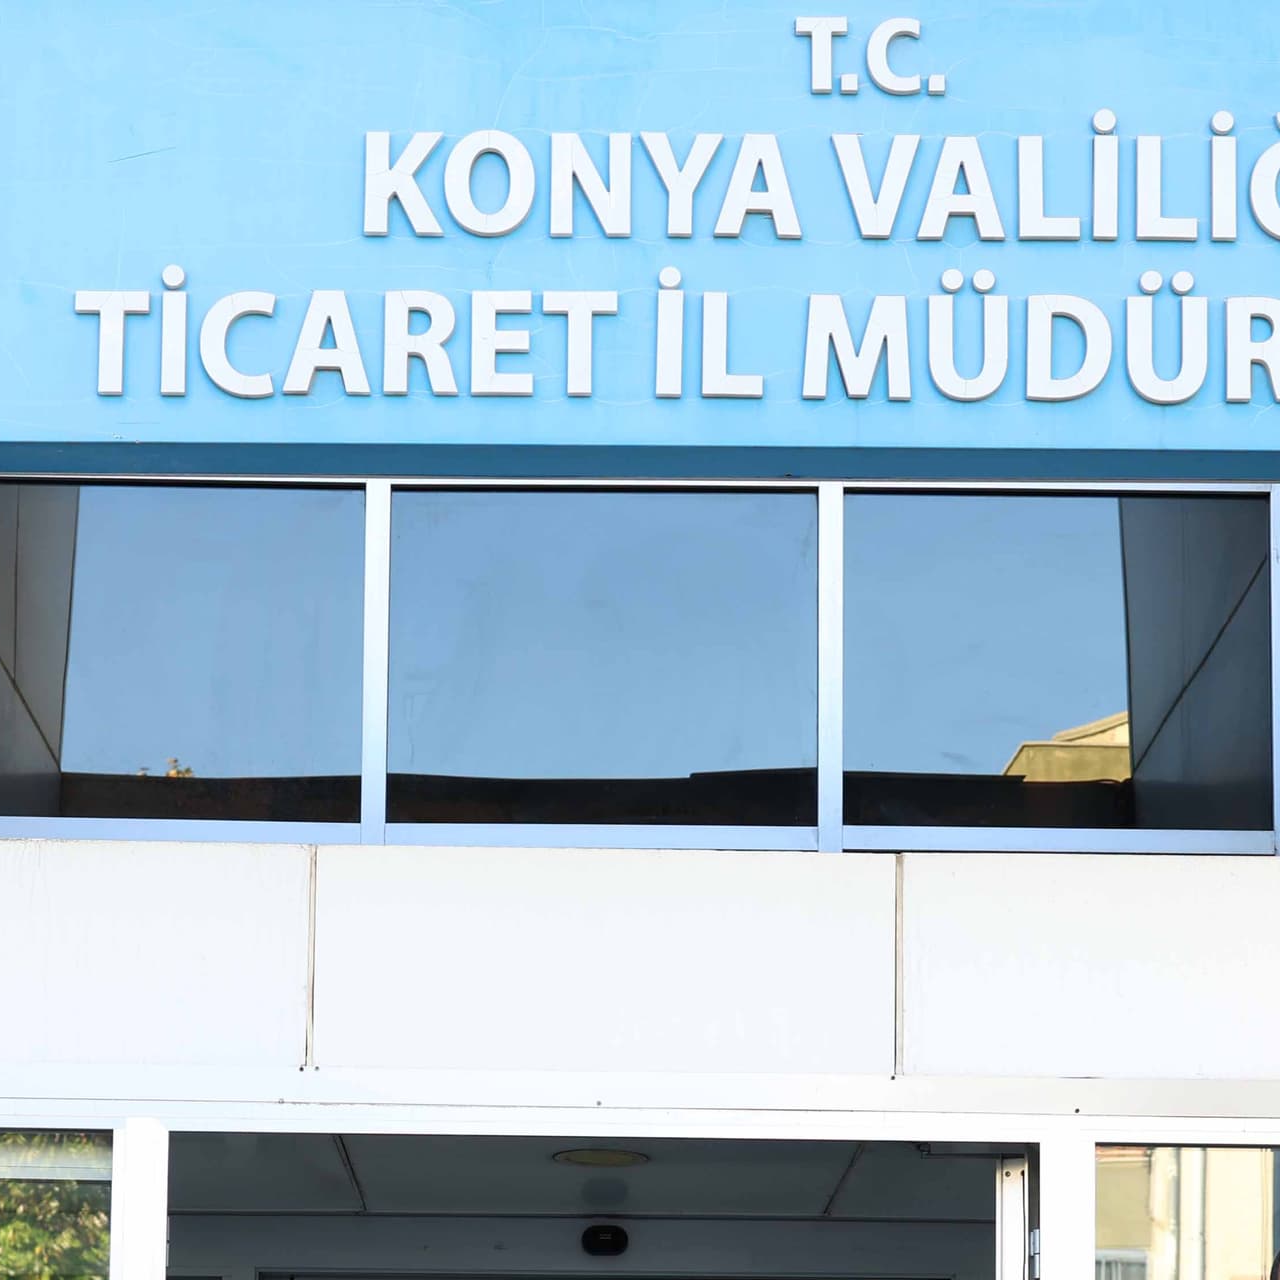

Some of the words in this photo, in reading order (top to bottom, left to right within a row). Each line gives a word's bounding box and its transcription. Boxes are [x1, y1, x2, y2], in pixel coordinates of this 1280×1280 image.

[794, 16, 946, 95] T.C.
[363, 129, 801, 240] KONYA
[75, 264, 618, 398] TİCARET
[655, 265, 764, 399] İL
